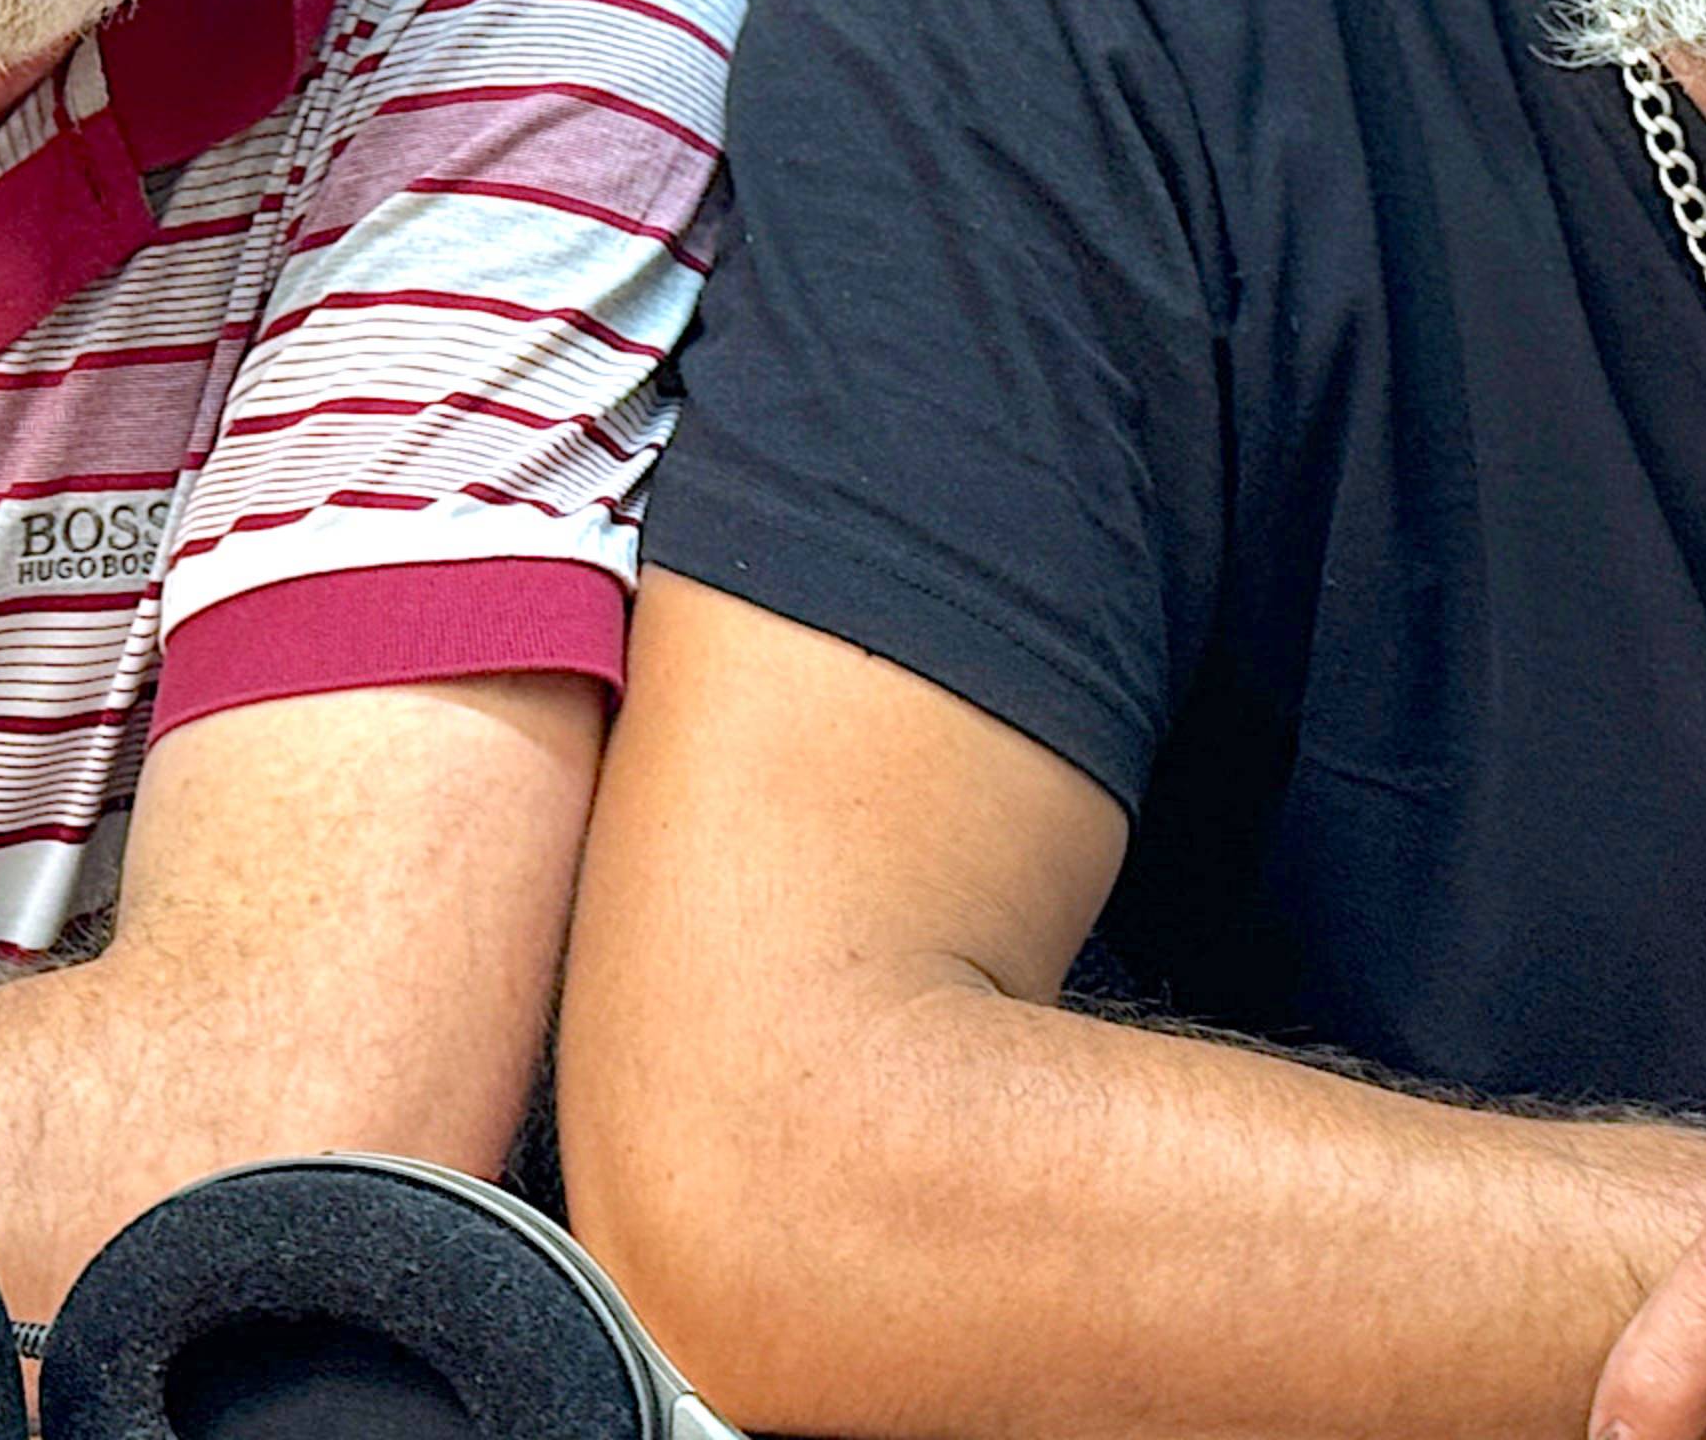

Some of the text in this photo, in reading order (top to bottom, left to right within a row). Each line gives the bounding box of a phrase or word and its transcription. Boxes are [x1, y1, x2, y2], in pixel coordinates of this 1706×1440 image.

[21, 500, 170, 558] BOSS
[19, 550, 157, 585] HUGO BOS
